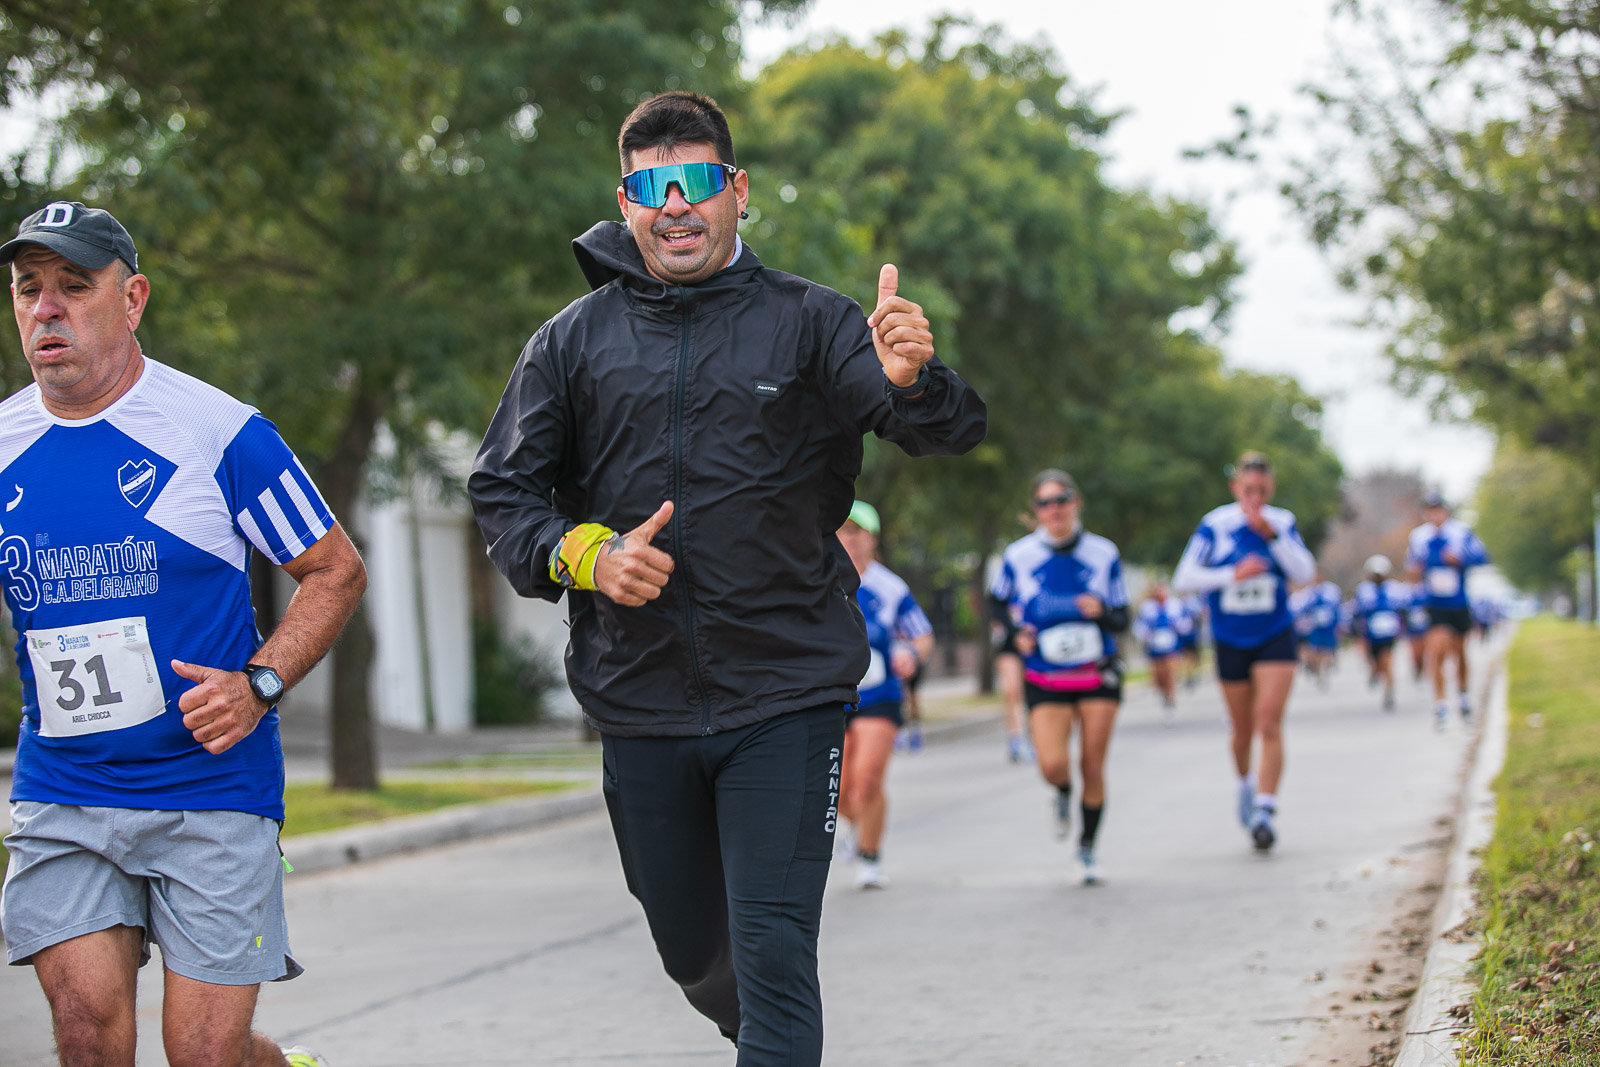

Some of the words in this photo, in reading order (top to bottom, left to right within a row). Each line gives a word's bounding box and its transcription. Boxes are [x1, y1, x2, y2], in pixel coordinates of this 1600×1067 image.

[38, 203, 74, 227] D
[0, 535, 40, 612] 3
[36, 536, 158, 580] MARATÓN
[42, 573, 159, 604] C.A.BELGRANO
[57, 634, 66, 653] 3
[50, 654, 123, 711] 31
[72, 714, 88, 724] ARIEL
[87, 710, 112, 722] CHIOCCA
[824, 747, 840, 833] PANTRO
